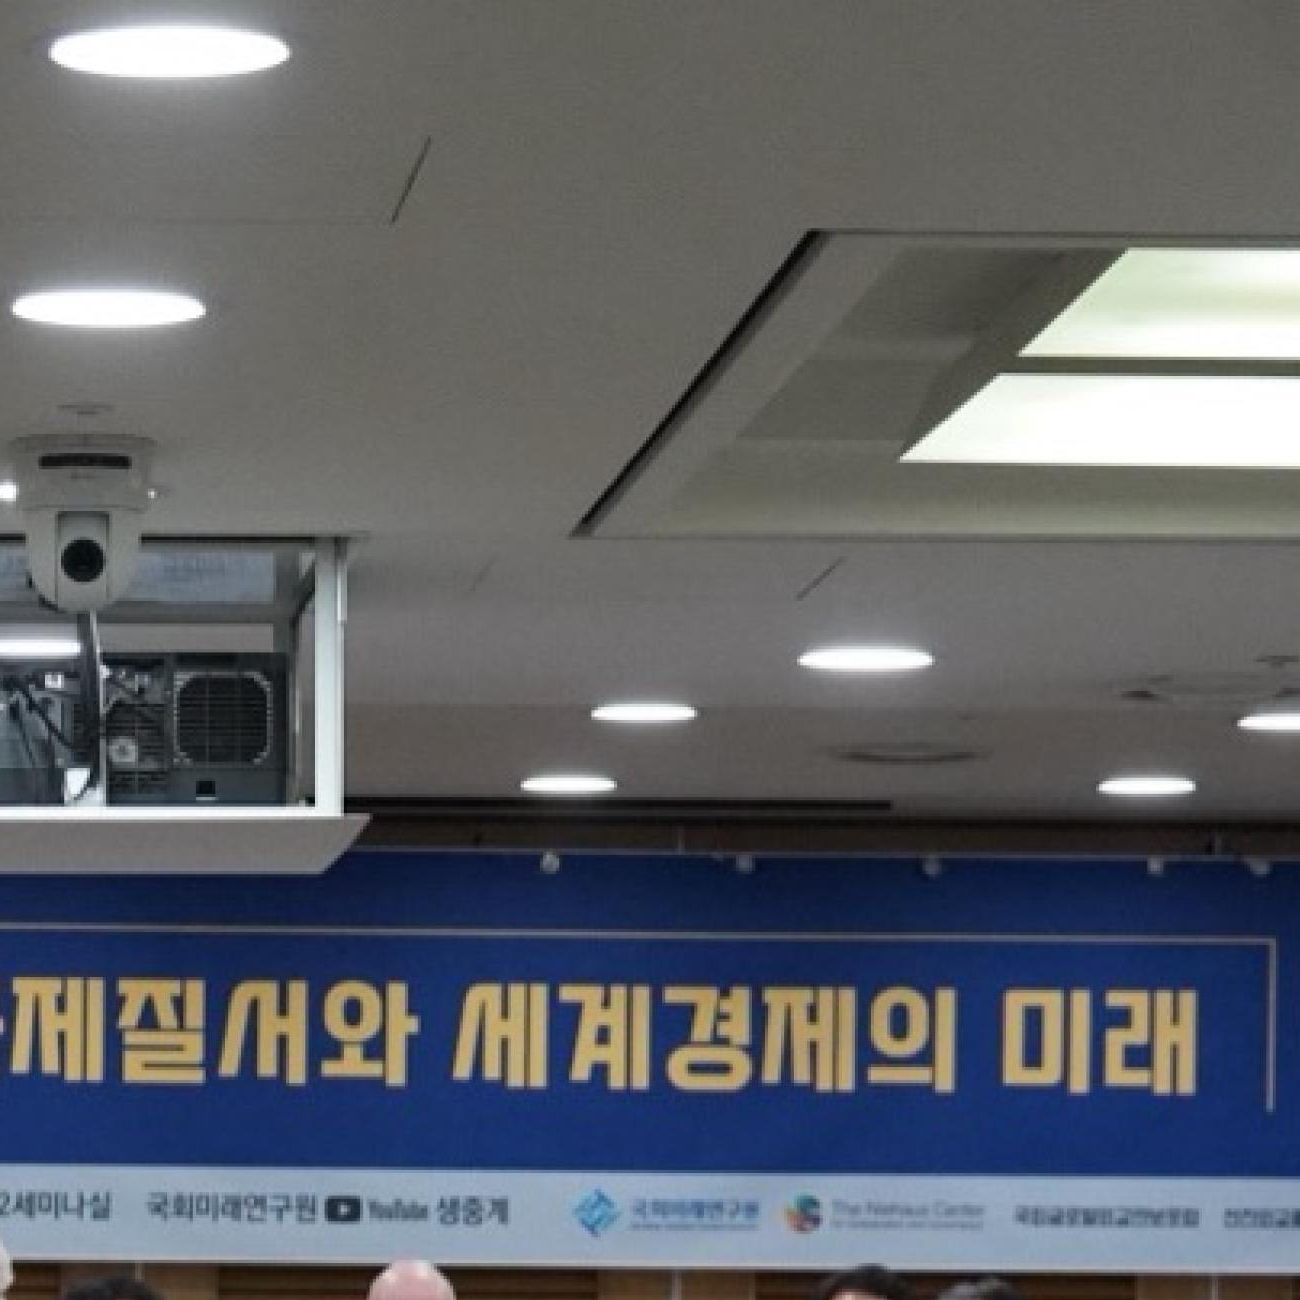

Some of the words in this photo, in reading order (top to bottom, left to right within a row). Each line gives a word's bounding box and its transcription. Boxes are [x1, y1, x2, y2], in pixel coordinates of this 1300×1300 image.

[451, 981, 957, 1093] 세계경제의
[1001, 987, 1198, 1096] 미래
[147, 1191, 319, 1224] 국회미래연구원
[437, 1195, 510, 1226] 생중계
